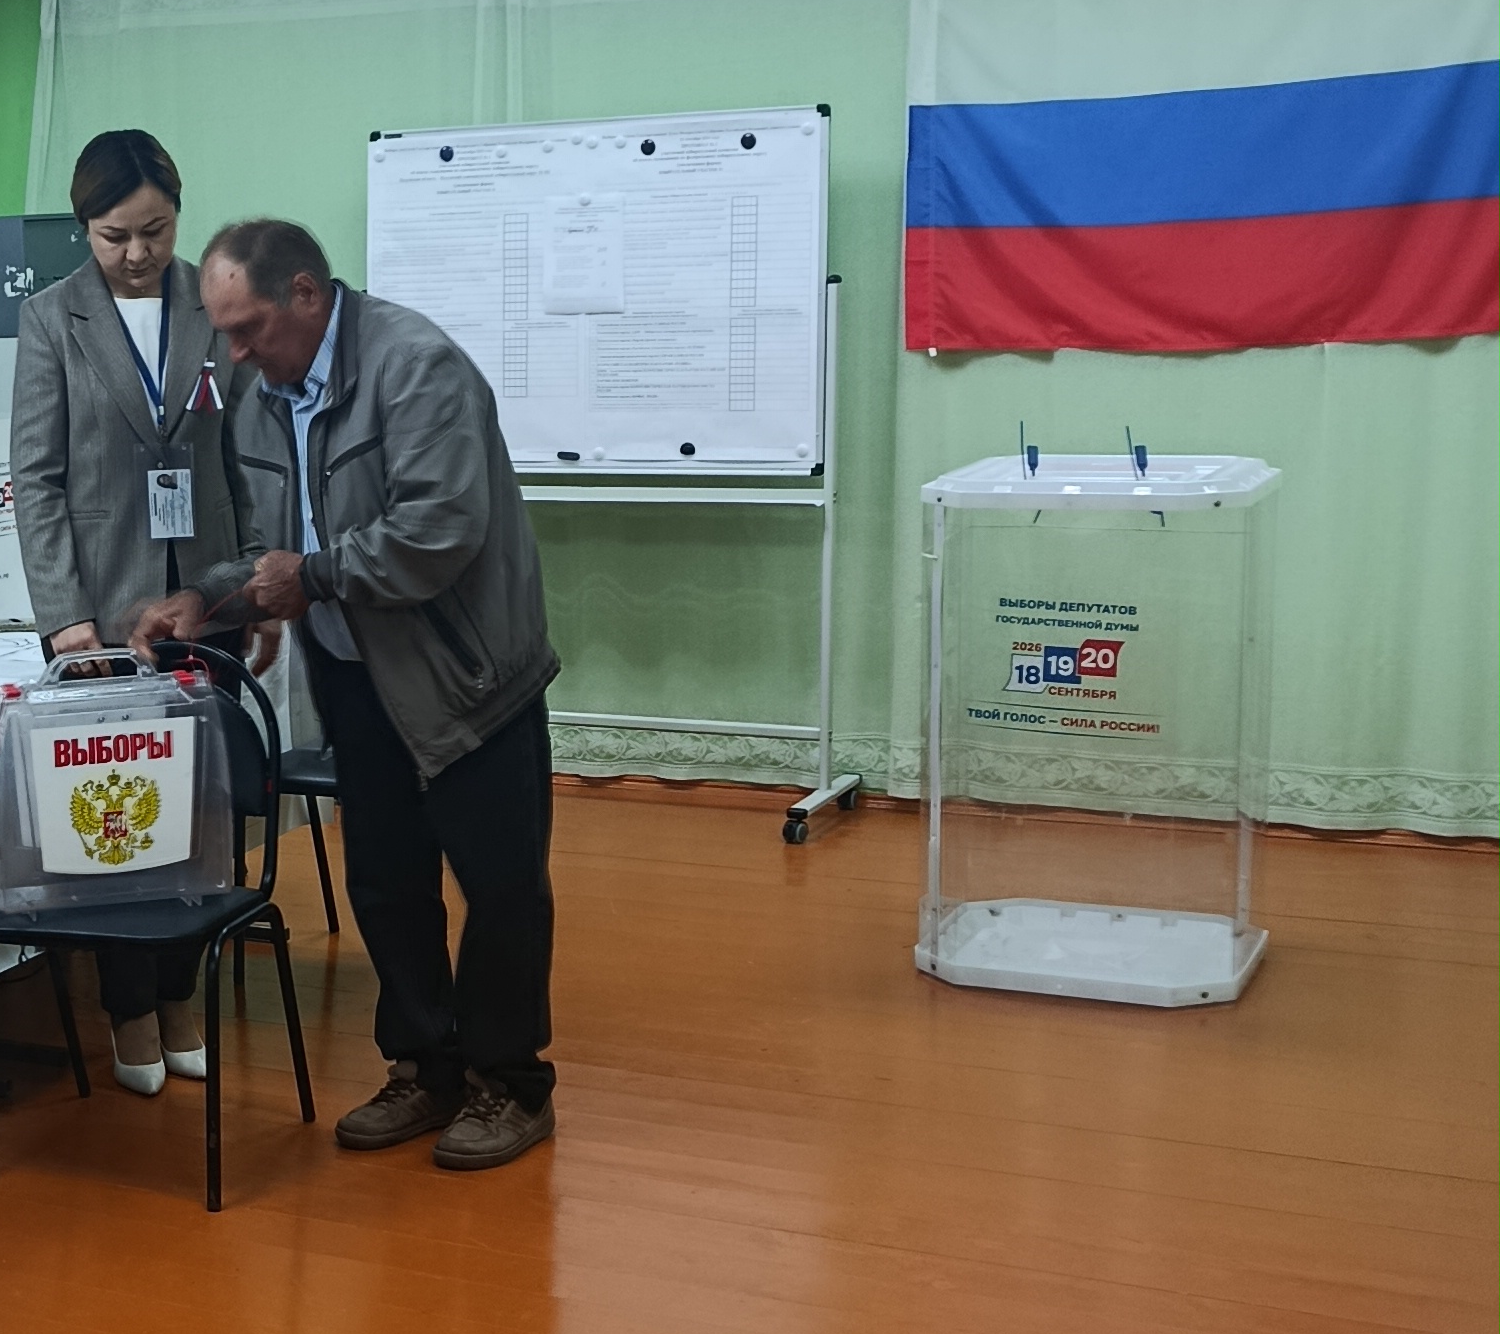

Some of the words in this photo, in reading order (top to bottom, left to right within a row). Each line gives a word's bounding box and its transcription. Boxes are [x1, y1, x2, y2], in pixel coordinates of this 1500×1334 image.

[999, 598, 1056, 611] ВЫБОРЫ
[1058, 602, 1137, 616] ДЕПУТАТОВ
[995, 615, 1102, 630] ГОСУДАРСТВЕННОЙ
[1104, 621, 1139, 632] ДУМЫ
[1012, 641, 1042, 652] 2026
[1047, 655, 1074, 676] 19
[1080, 648, 1115, 669] 20
[1015, 664, 1041, 685] 18
[1048, 686, 1117, 700] СЕНТЯБРЯ
[967, 708, 1001, 721] ТВОЙ
[1003, 711, 1046, 725] ГОЛОС
[1060, 717, 1097, 730] СИЛА
[1100, 720, 1160, 734] РОССИИ!
[54, 730, 173, 768] ВЫБОРЫ
